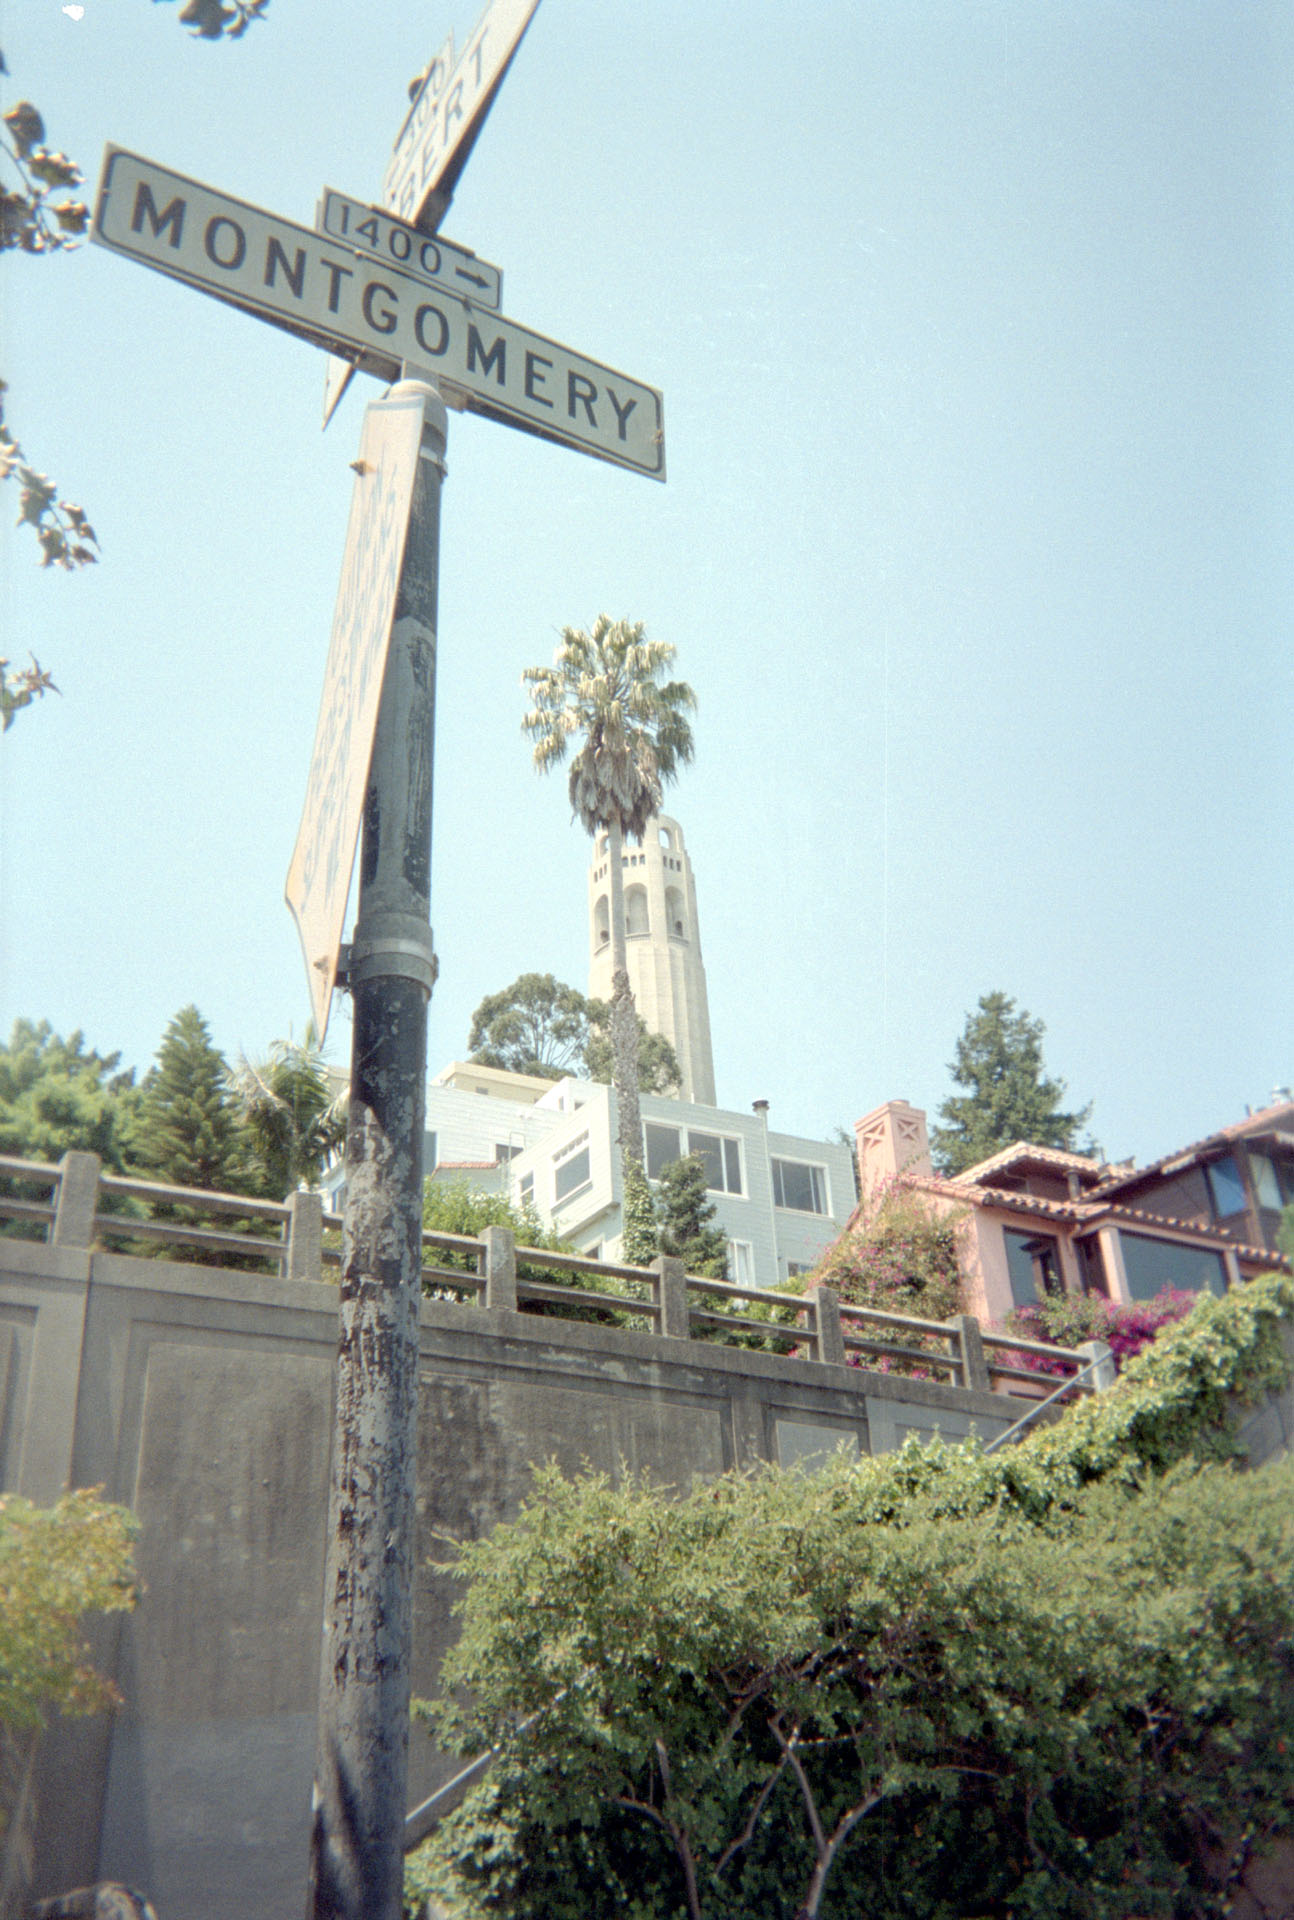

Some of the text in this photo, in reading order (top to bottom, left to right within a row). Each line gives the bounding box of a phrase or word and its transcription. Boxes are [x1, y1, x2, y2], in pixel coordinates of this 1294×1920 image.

[401, 27, 489, 217] BERT
[131, 182, 637, 441] MONTGOMERY
[340, 203, 442, 275] 1400
